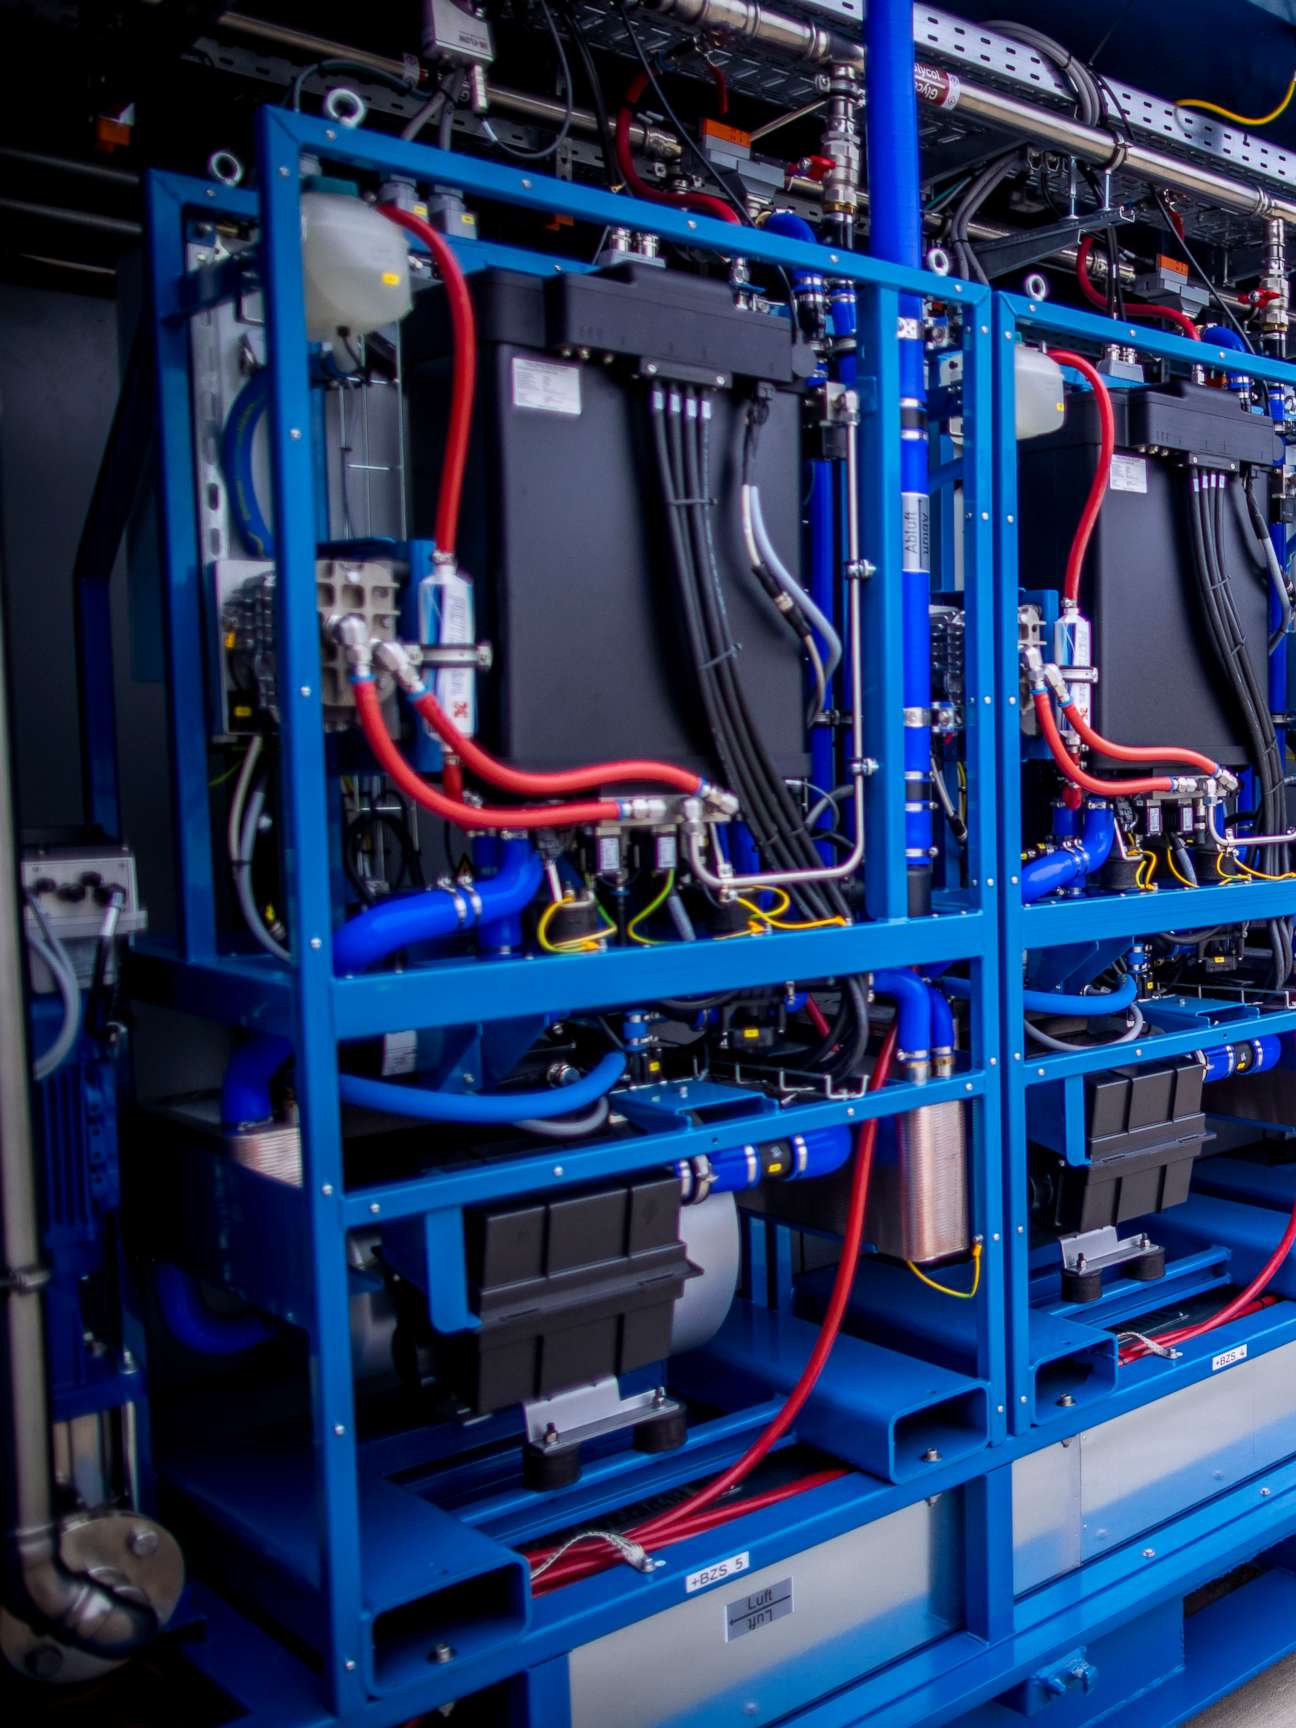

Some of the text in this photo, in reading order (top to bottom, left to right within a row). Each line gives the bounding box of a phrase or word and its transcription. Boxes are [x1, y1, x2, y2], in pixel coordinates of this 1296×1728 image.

[903, 511, 918, 554] Abluft
[1215, 1351, 1236, 1367] +BZS
[691, 1556, 744, 1587] +BZS 5
[747, 1588, 773, 1610] Luft
[747, 1608, 773, 1631] Luft
